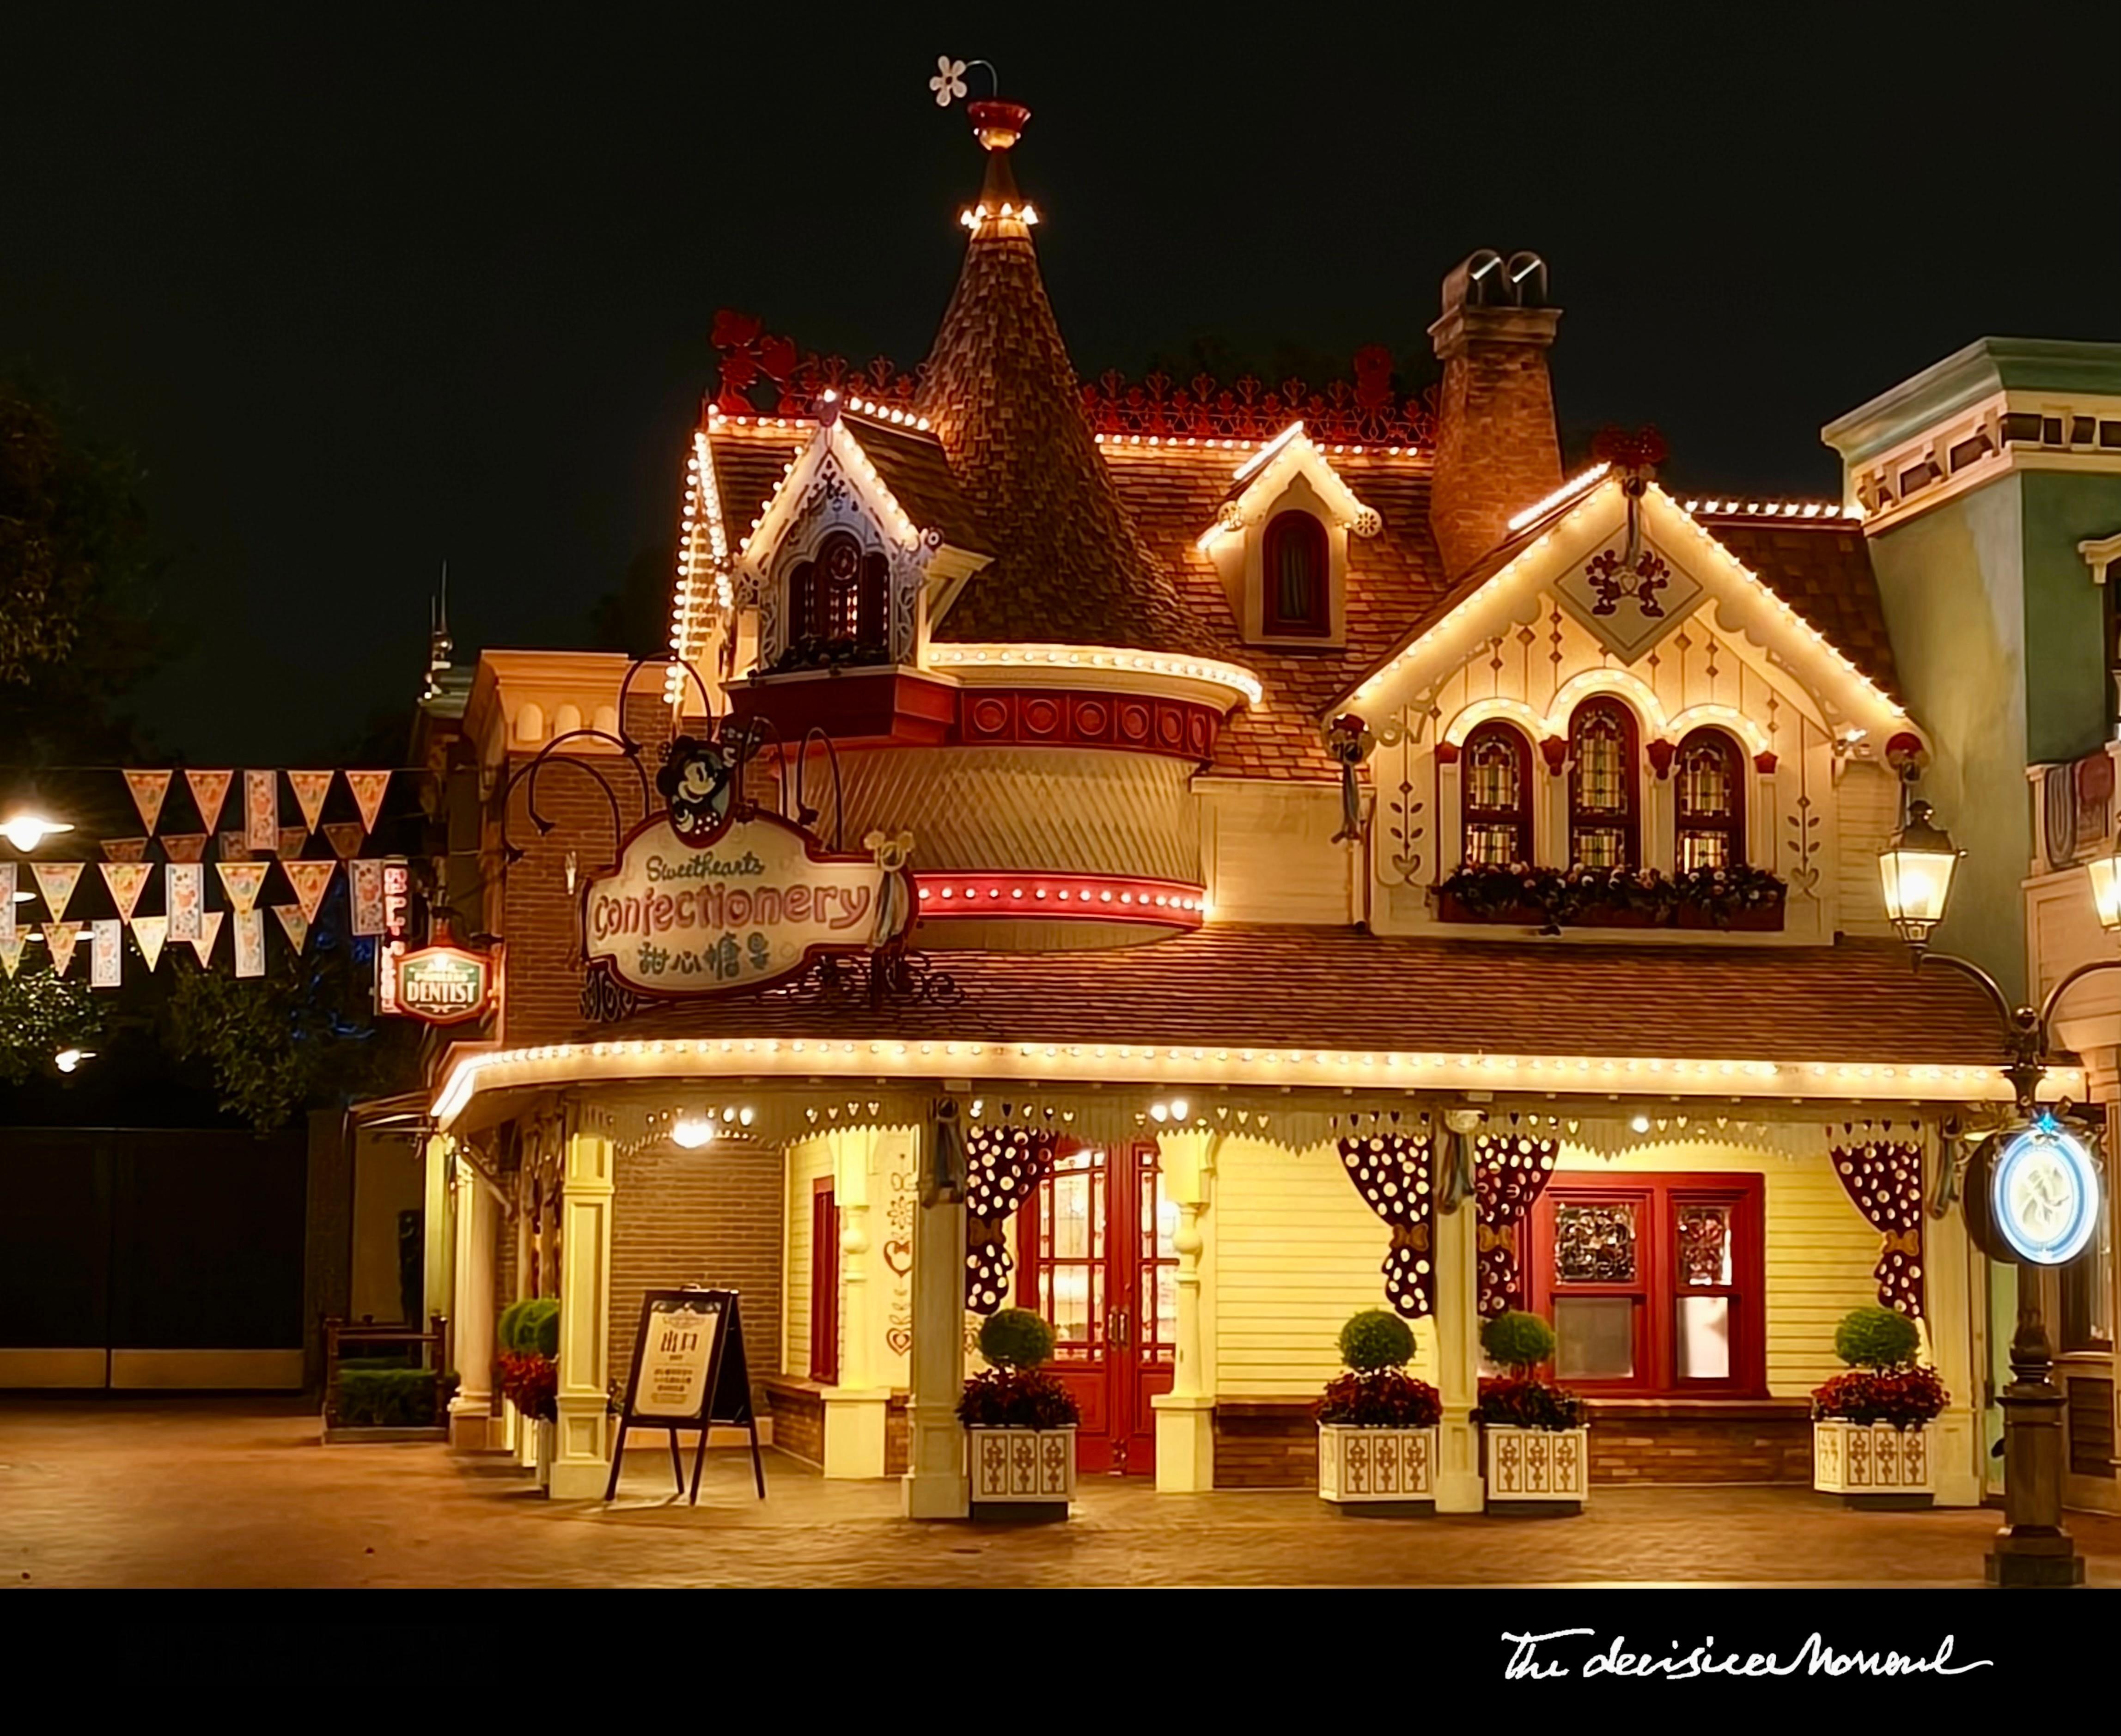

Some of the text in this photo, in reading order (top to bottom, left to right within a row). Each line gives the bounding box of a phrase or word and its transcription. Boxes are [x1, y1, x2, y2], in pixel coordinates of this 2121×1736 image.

[646, 851, 765, 882] Sweethearts
[593, 882, 871, 941] Confectionery
[407, 981, 476, 1003] DENTIST
